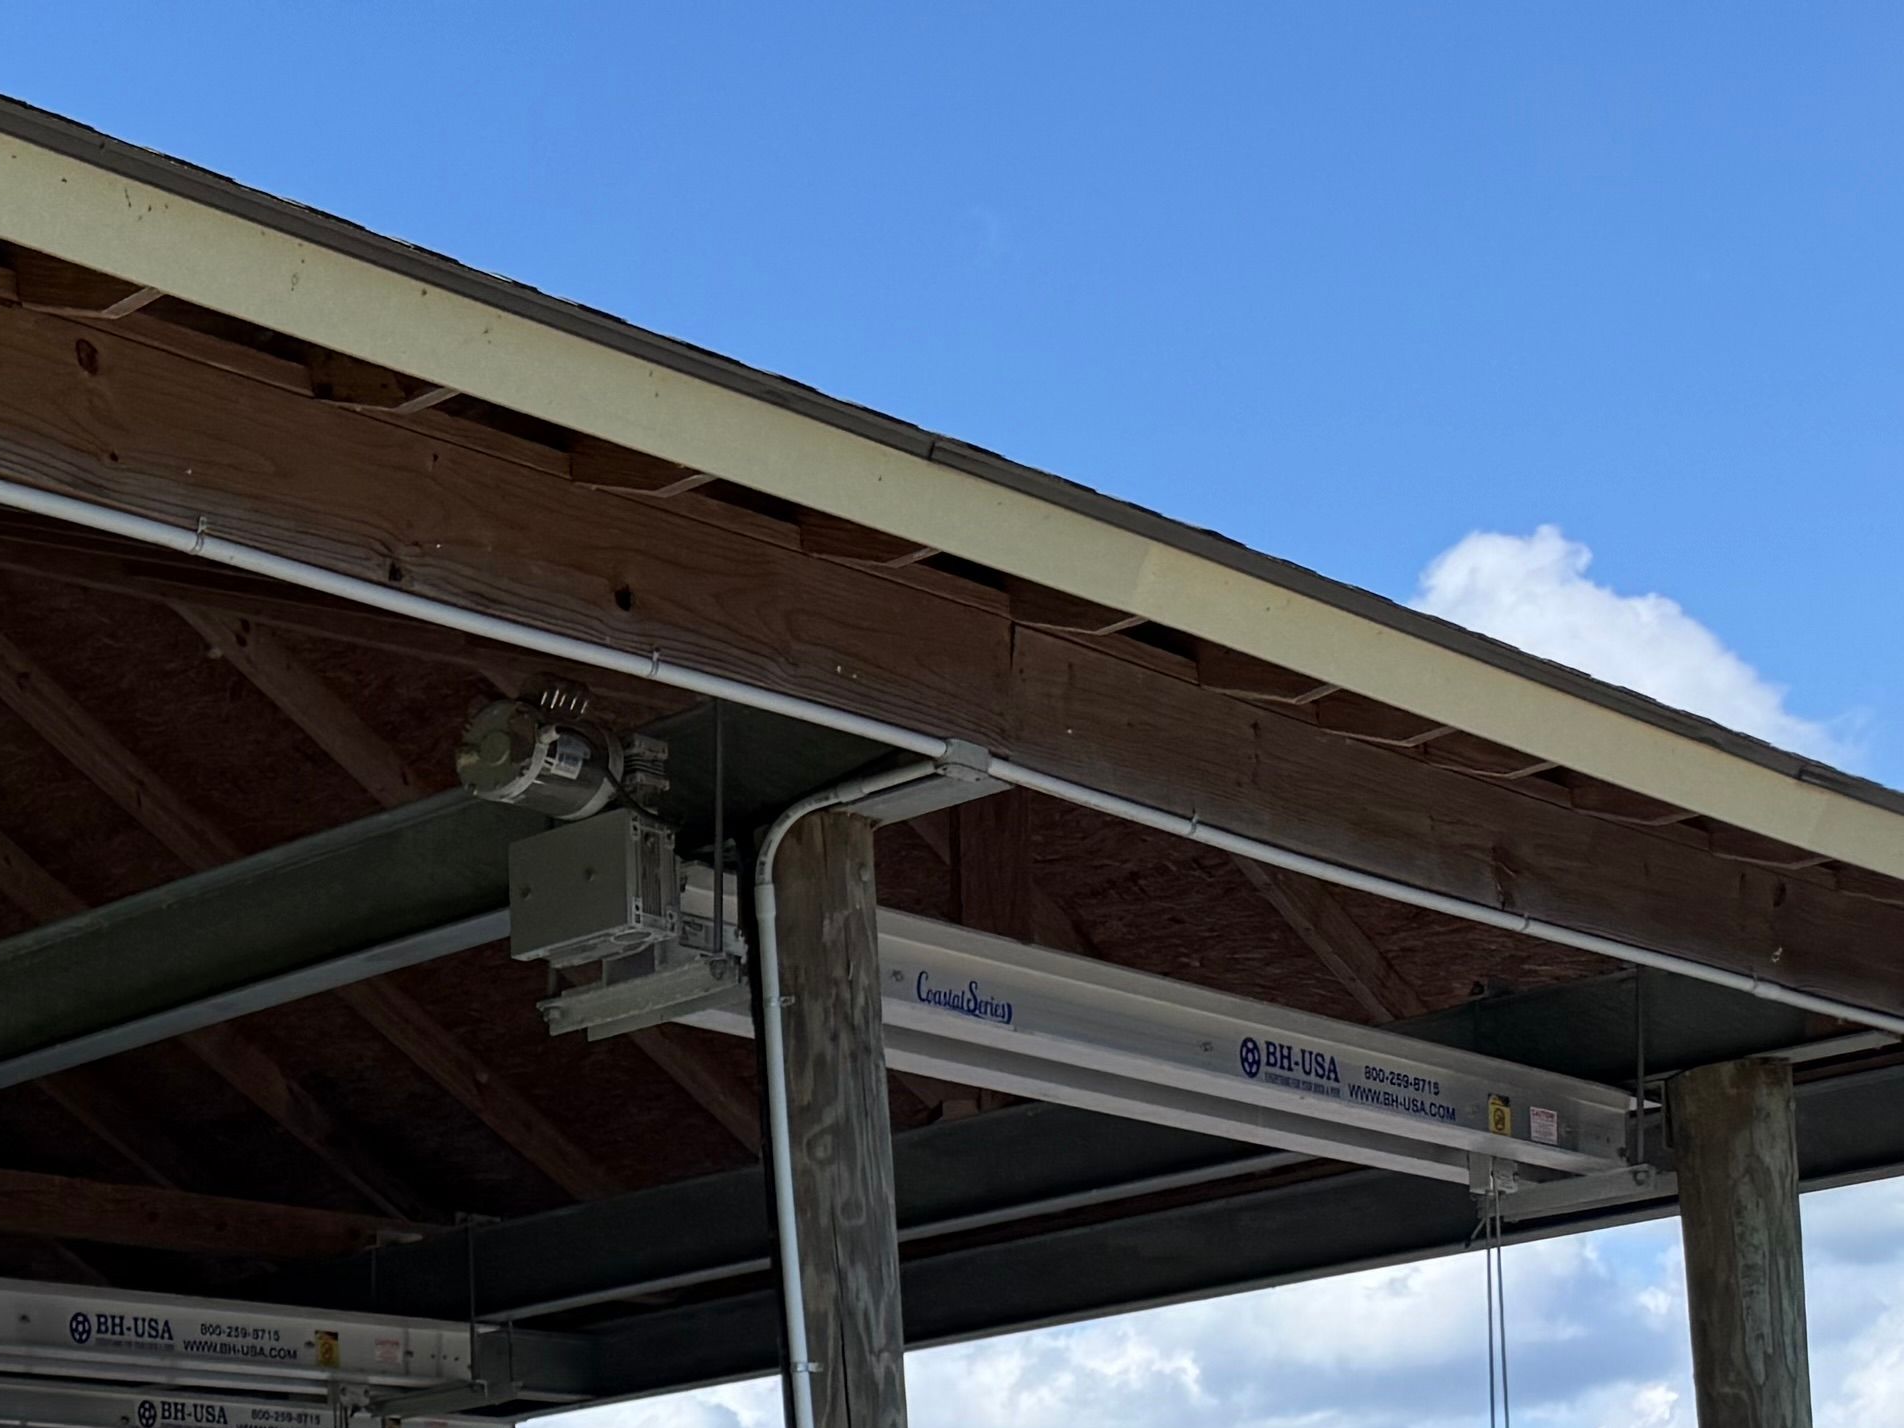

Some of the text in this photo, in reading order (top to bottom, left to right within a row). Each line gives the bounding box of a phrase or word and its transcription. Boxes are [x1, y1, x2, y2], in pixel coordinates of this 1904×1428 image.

[917, 970, 1013, 1024] Coastal Series
[1264, 1040, 1341, 1083] BH-USA
[1348, 1083, 1456, 1121] WWW.BH-USA.COM
[95, 1314, 174, 1341] BH-USA
[183, 1340, 298, 1360] WWW.BH-USA.COM
[160, 1401, 228, 1425] BH-USA
